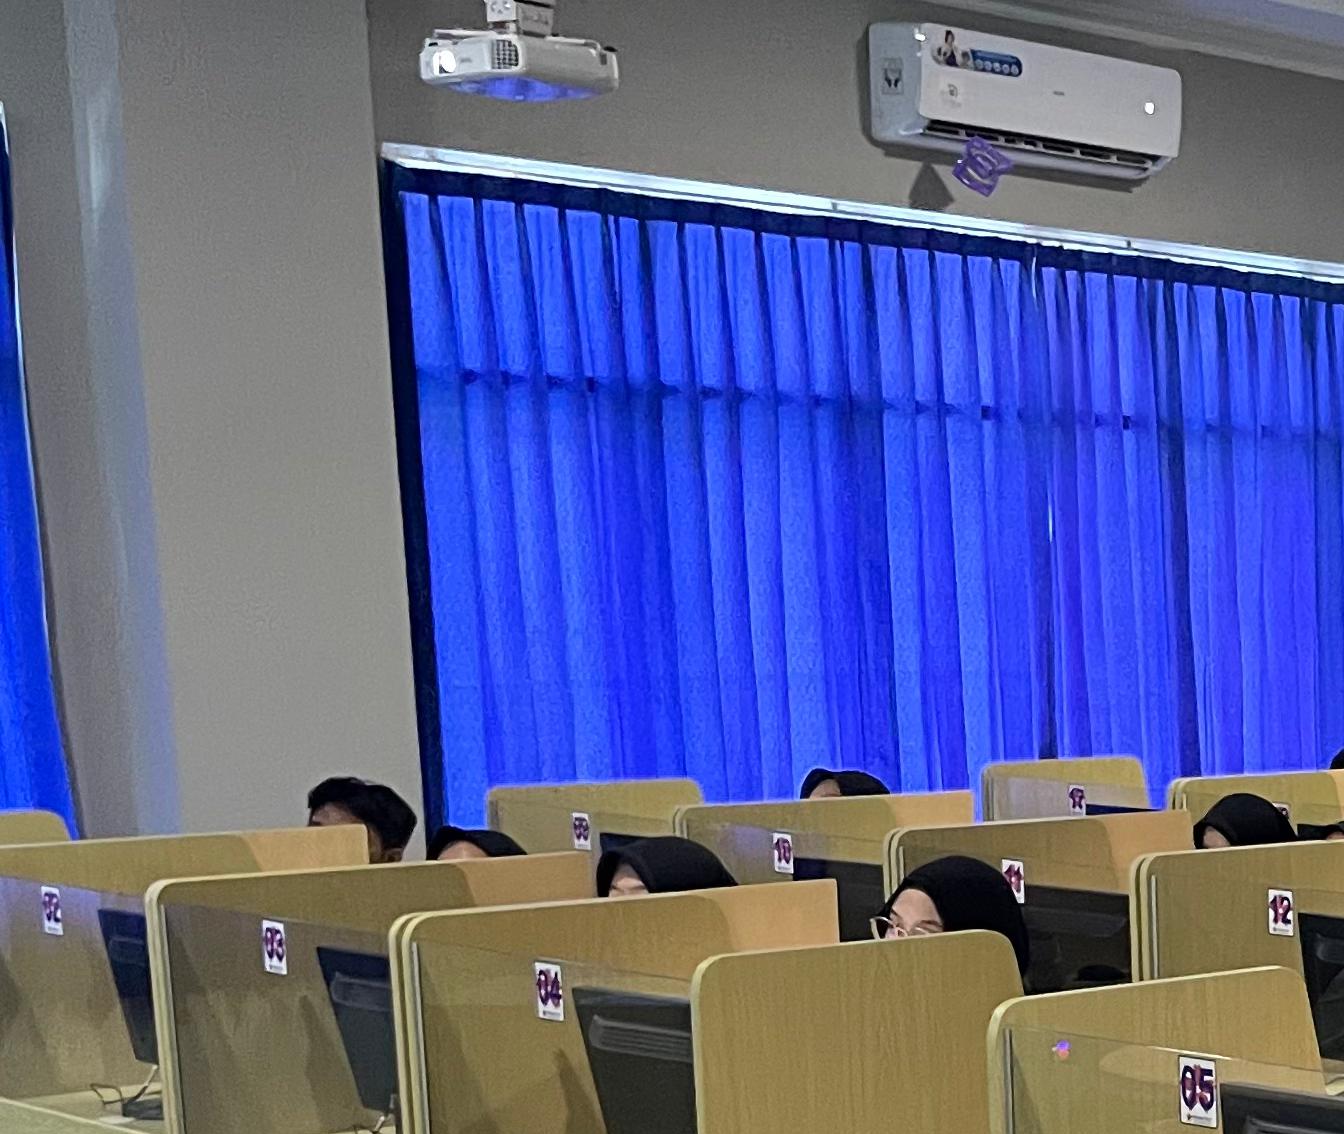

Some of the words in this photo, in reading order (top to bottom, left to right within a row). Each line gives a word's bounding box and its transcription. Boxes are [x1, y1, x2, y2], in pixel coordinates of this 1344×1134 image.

[774, 837, 791, 864] 10
[43, 893, 60, 922] 02
[1270, 895, 1291, 924] 12
[265, 927, 285, 962] 03
[537, 969, 562, 1006] 04
[1181, 1065, 1214, 1112] 05
